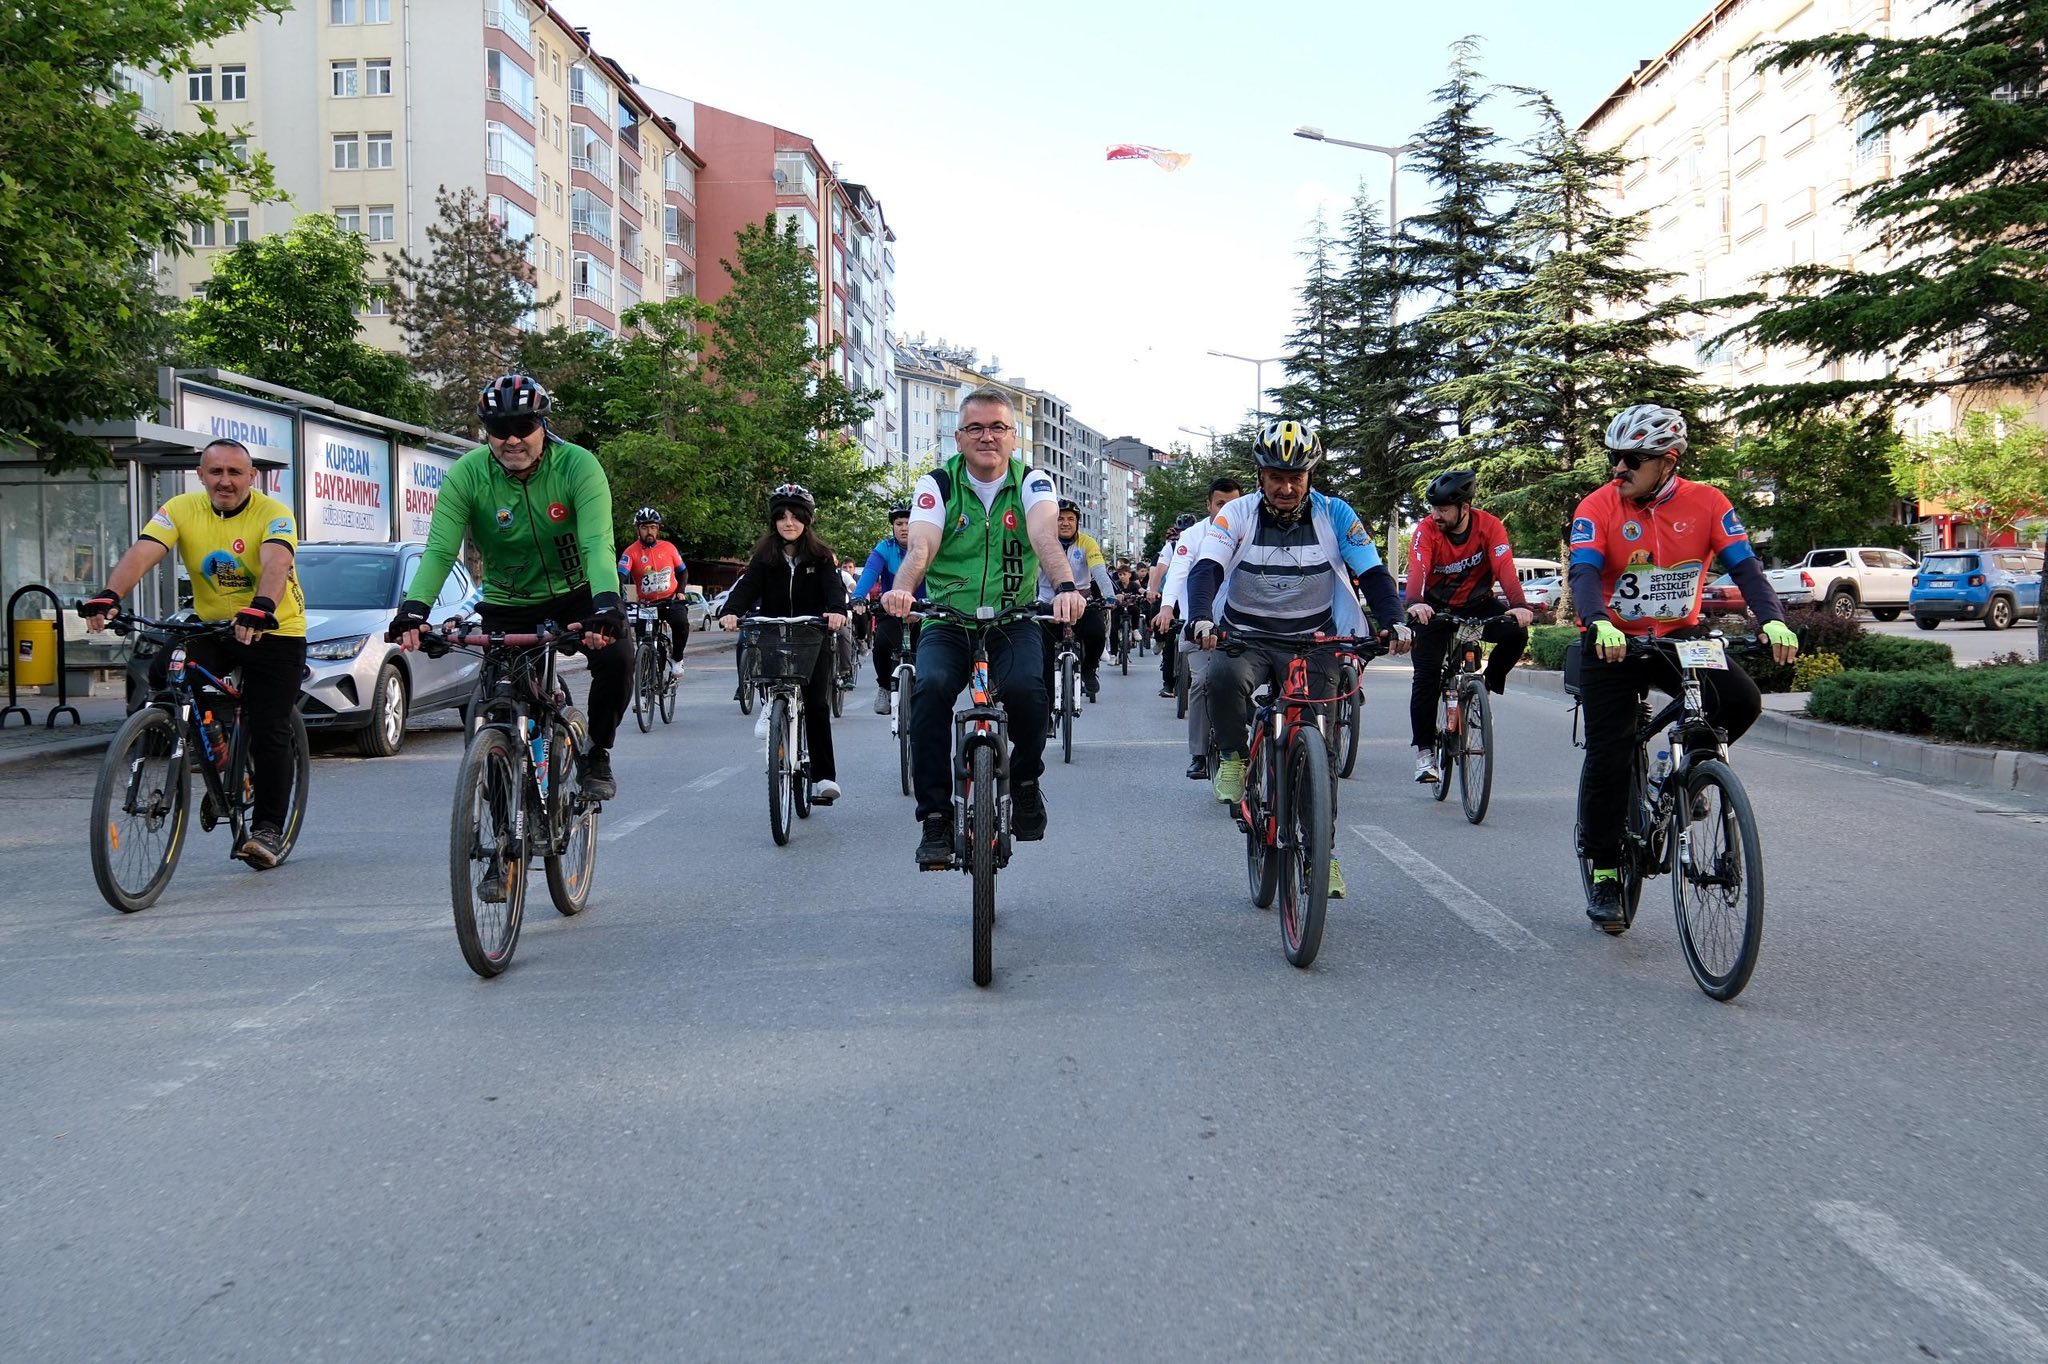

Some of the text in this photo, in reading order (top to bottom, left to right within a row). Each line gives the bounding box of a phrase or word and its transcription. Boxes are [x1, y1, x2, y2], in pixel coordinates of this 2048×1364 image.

[325, 442, 370, 476] KURBAN
[413, 462, 446, 489] KURBA
[314, 472, 381, 509] BAYRAMIMIZ
[355, 513, 375, 531] OLSUN
[1619, 572, 1649, 600] 3.
